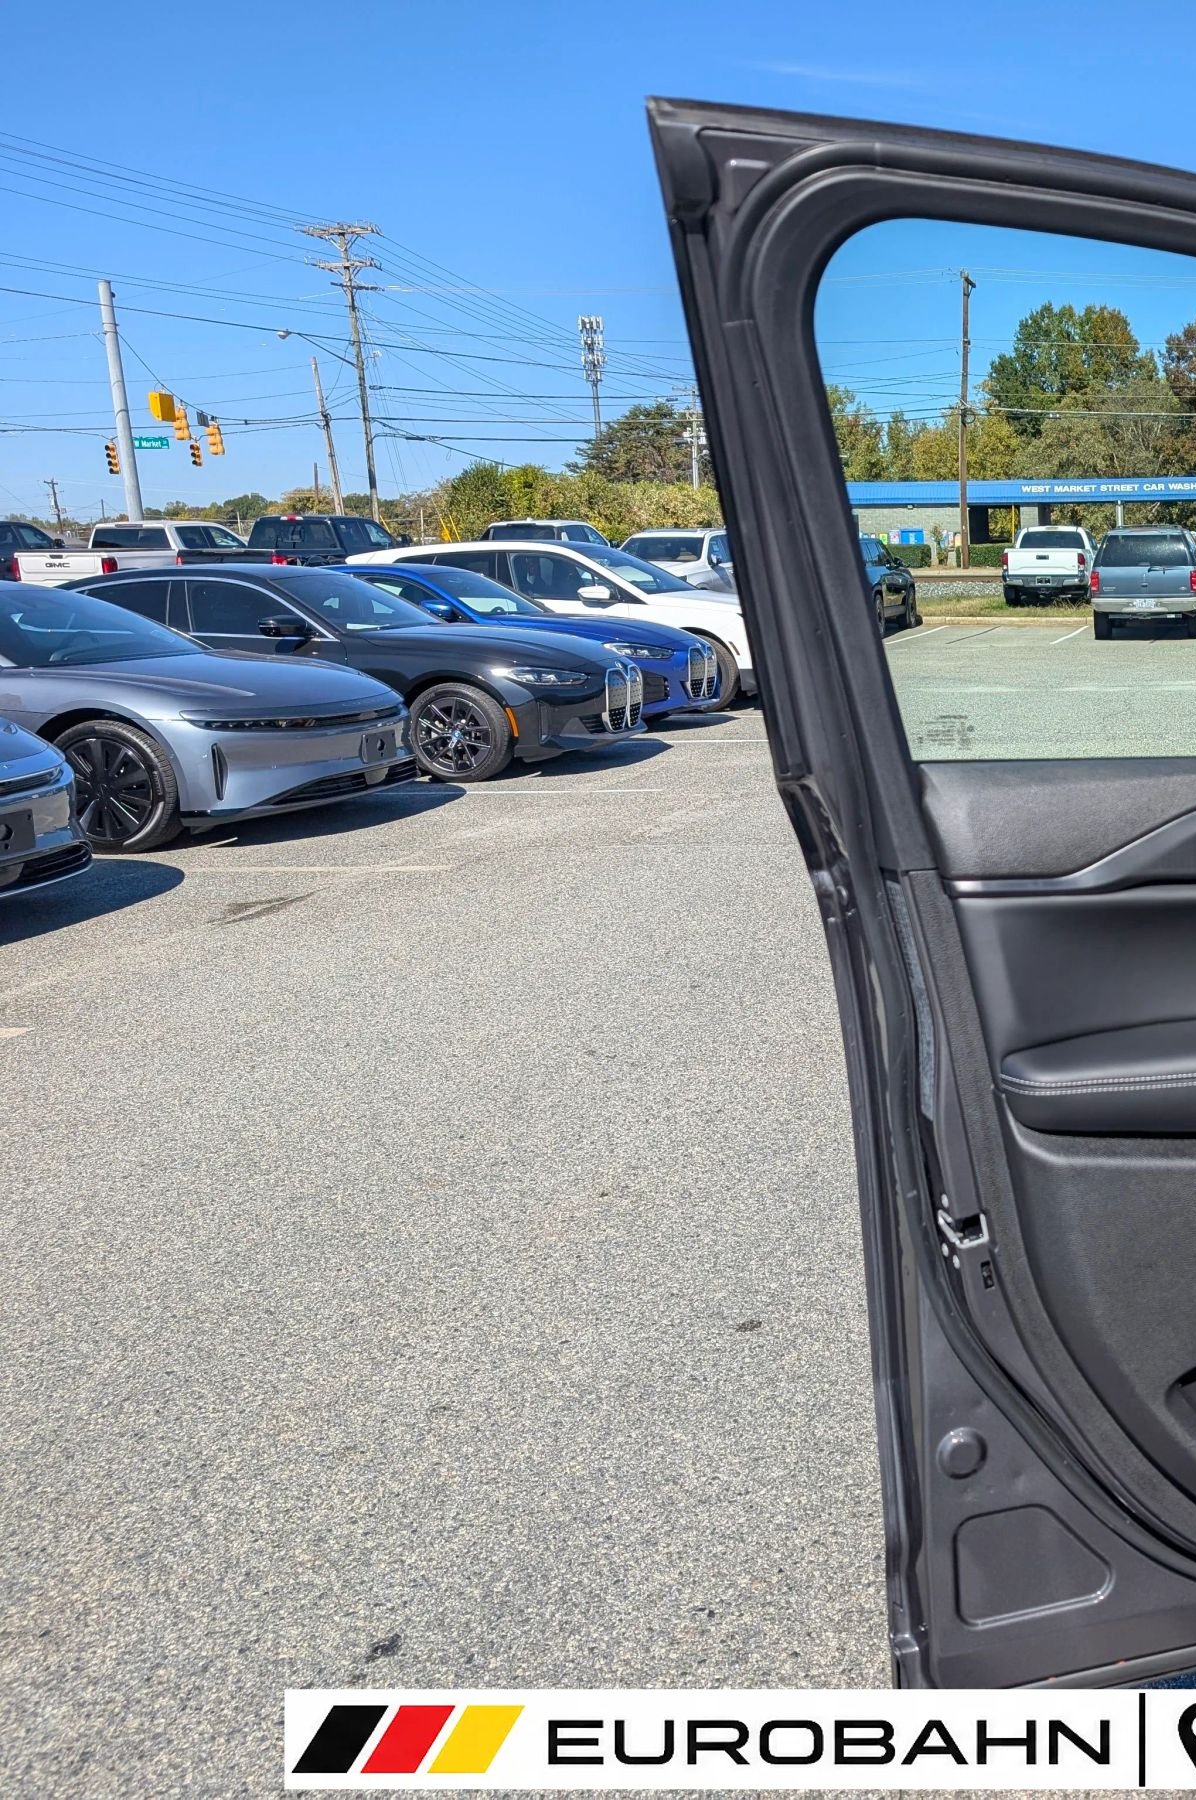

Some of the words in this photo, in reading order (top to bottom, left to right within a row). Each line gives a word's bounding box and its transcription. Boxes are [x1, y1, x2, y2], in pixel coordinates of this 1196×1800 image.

[141, 440, 162, 448] Market
[1022, 485, 1051, 493] WEST
[1054, 485, 1097, 493] MARKET
[1100, 484, 1140, 492] STREET
[1143, 483, 1165, 491] CAR
